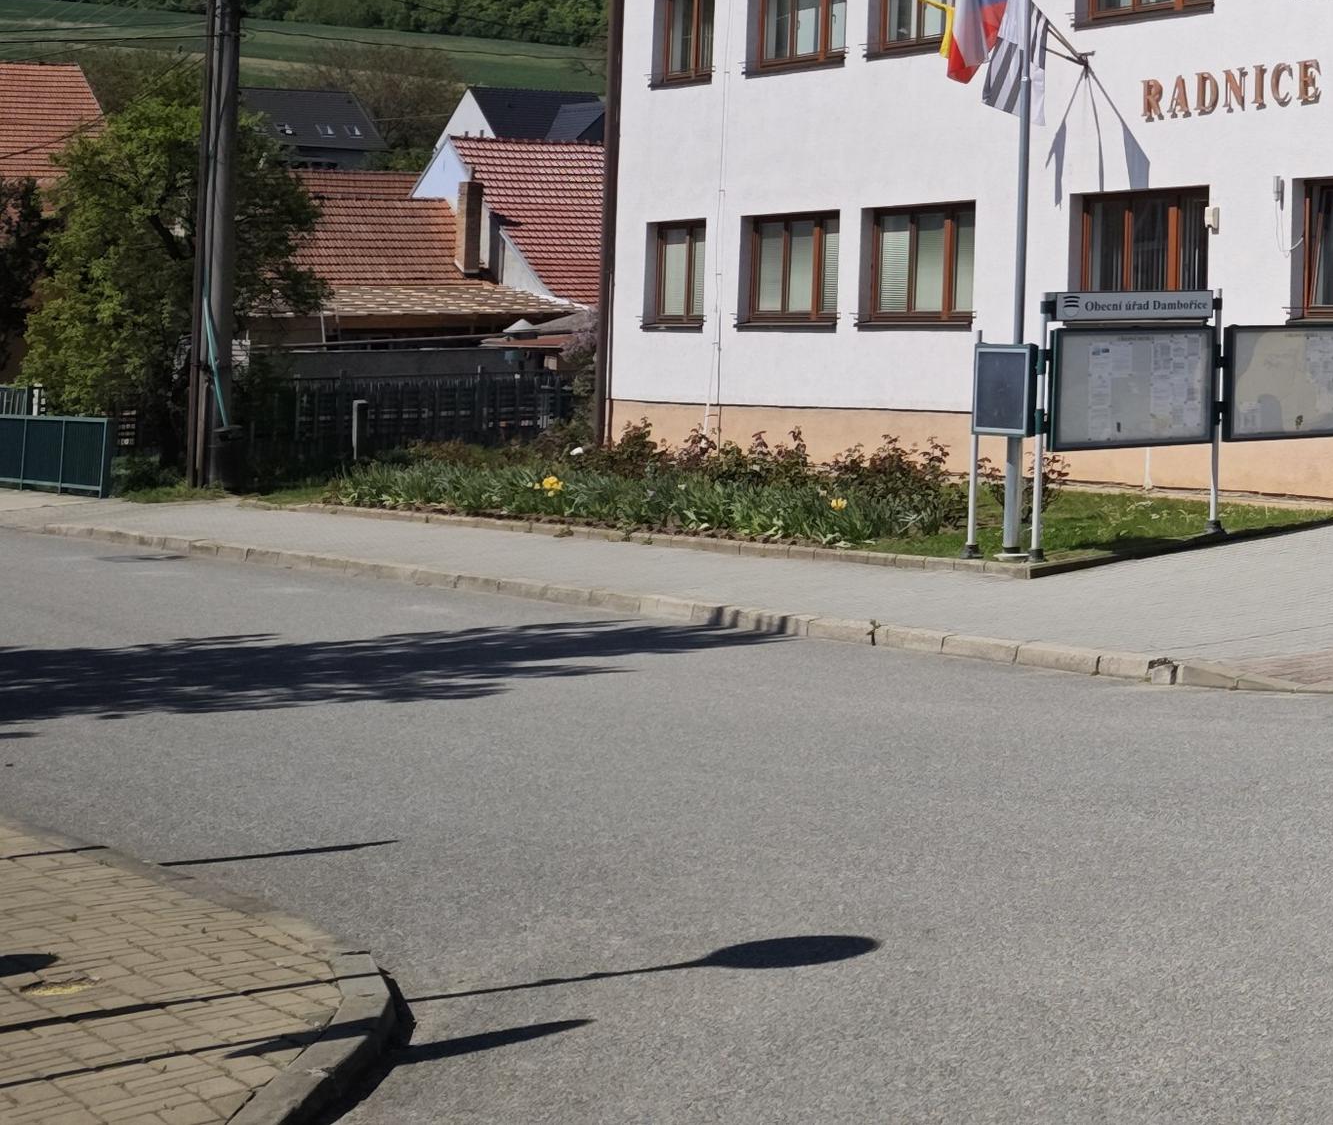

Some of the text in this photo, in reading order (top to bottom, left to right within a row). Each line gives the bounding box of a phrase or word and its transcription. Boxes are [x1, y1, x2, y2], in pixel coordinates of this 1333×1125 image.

[1141, 59, 1321, 122] RADNICE
[1084, 300, 1208, 312] Obecní úřad Dambořice
